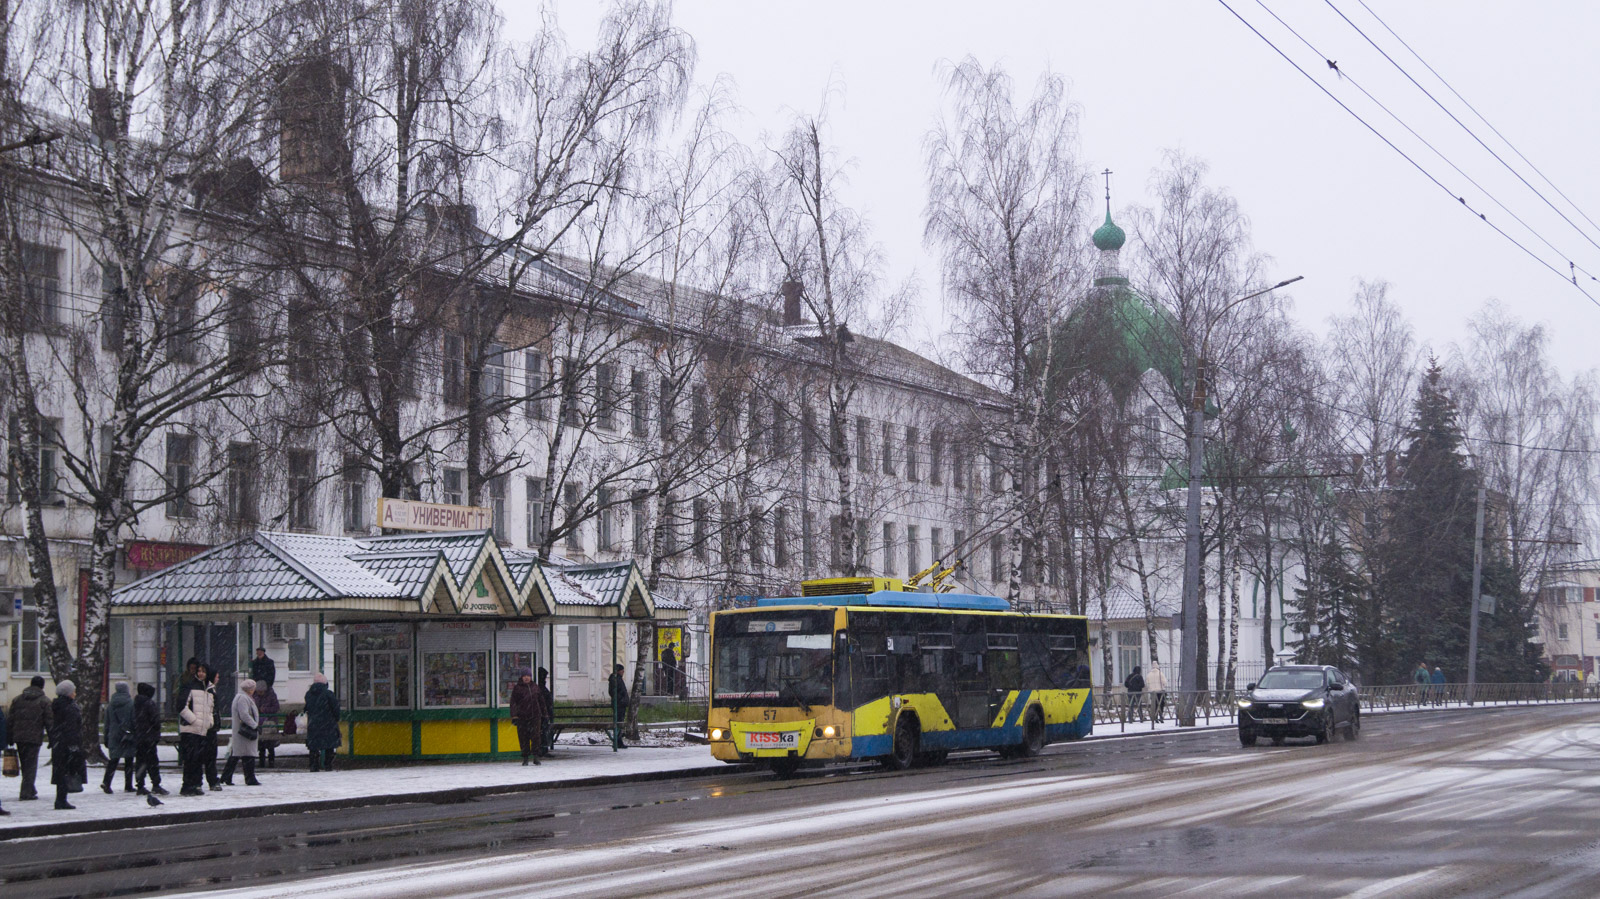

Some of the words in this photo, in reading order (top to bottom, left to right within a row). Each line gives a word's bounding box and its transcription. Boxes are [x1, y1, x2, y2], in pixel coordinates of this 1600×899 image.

[384, 504, 394, 522] А
[413, 506, 473, 529] УНИВЕРМАГ
[763, 709, 777, 721] 57
